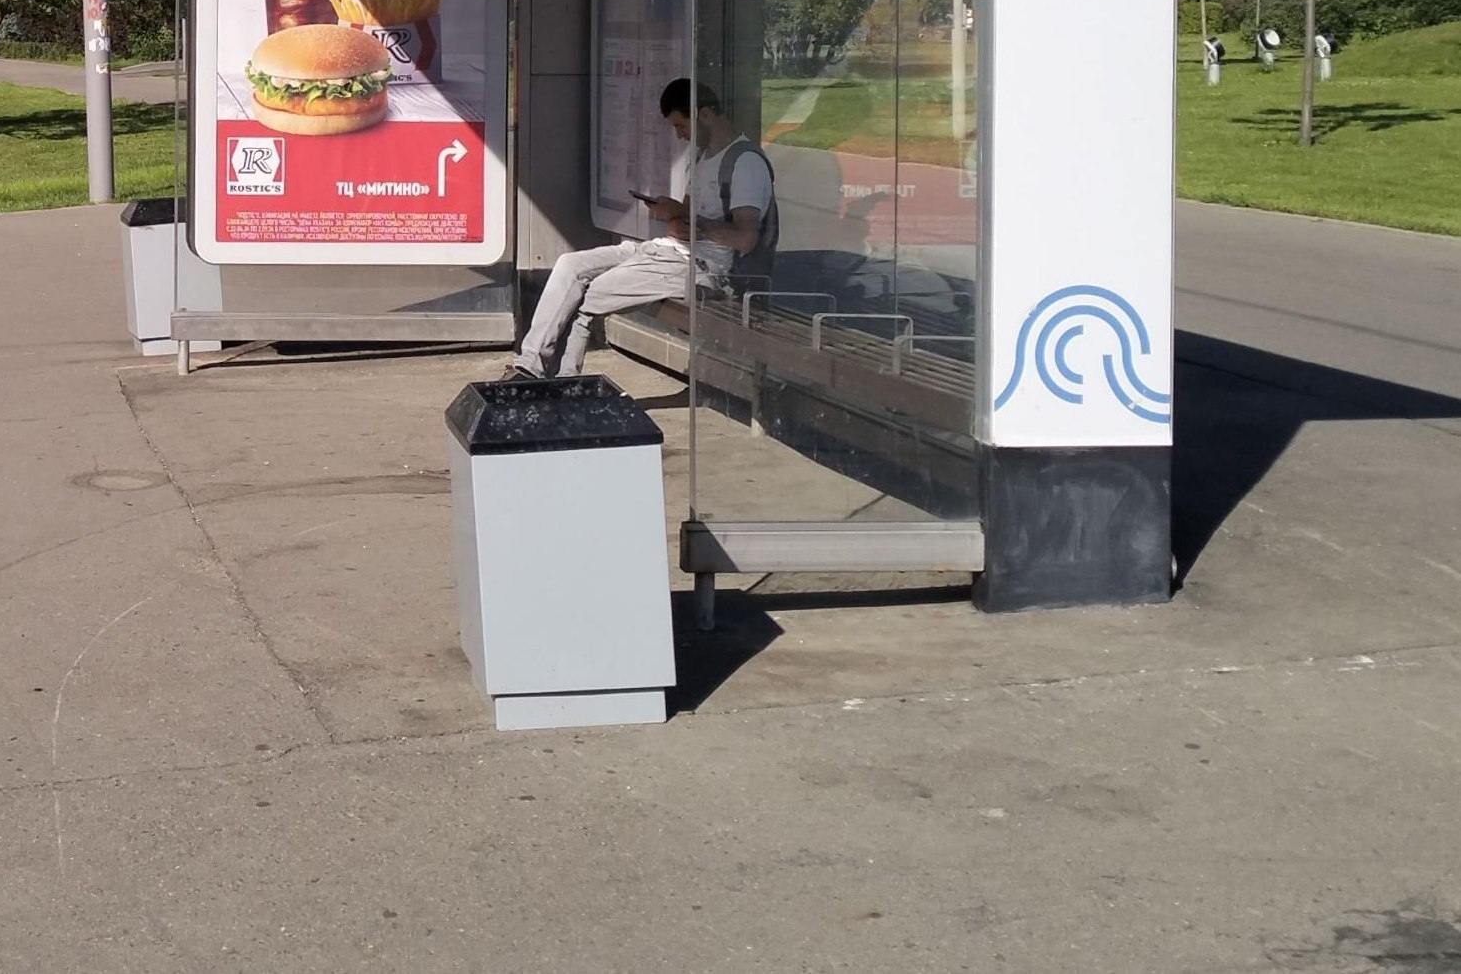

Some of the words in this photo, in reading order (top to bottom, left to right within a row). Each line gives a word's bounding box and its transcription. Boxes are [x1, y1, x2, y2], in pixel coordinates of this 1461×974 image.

[229, 184, 282, 193] ROSTIC'S
[336, 182, 354, 198] ТЦ
[357, 182, 430, 197] «МИТИНО»
